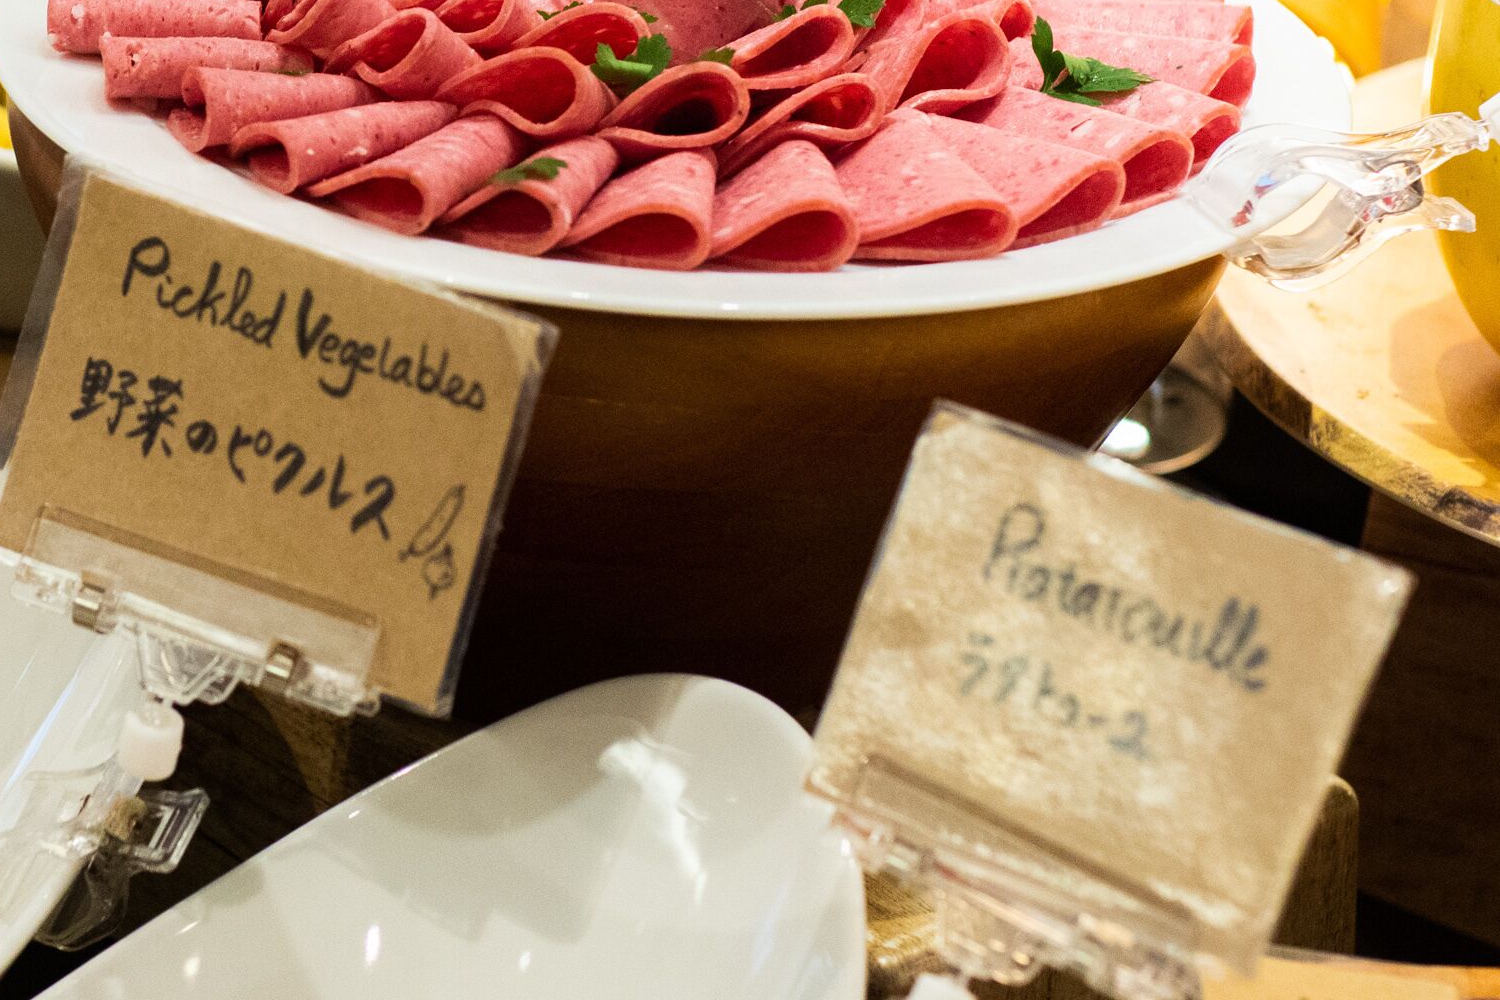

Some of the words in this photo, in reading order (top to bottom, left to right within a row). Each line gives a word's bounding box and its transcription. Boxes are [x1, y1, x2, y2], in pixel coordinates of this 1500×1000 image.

[121, 236, 287, 349] Pickled
[69, 355, 397, 541] 野菜のピクルス
